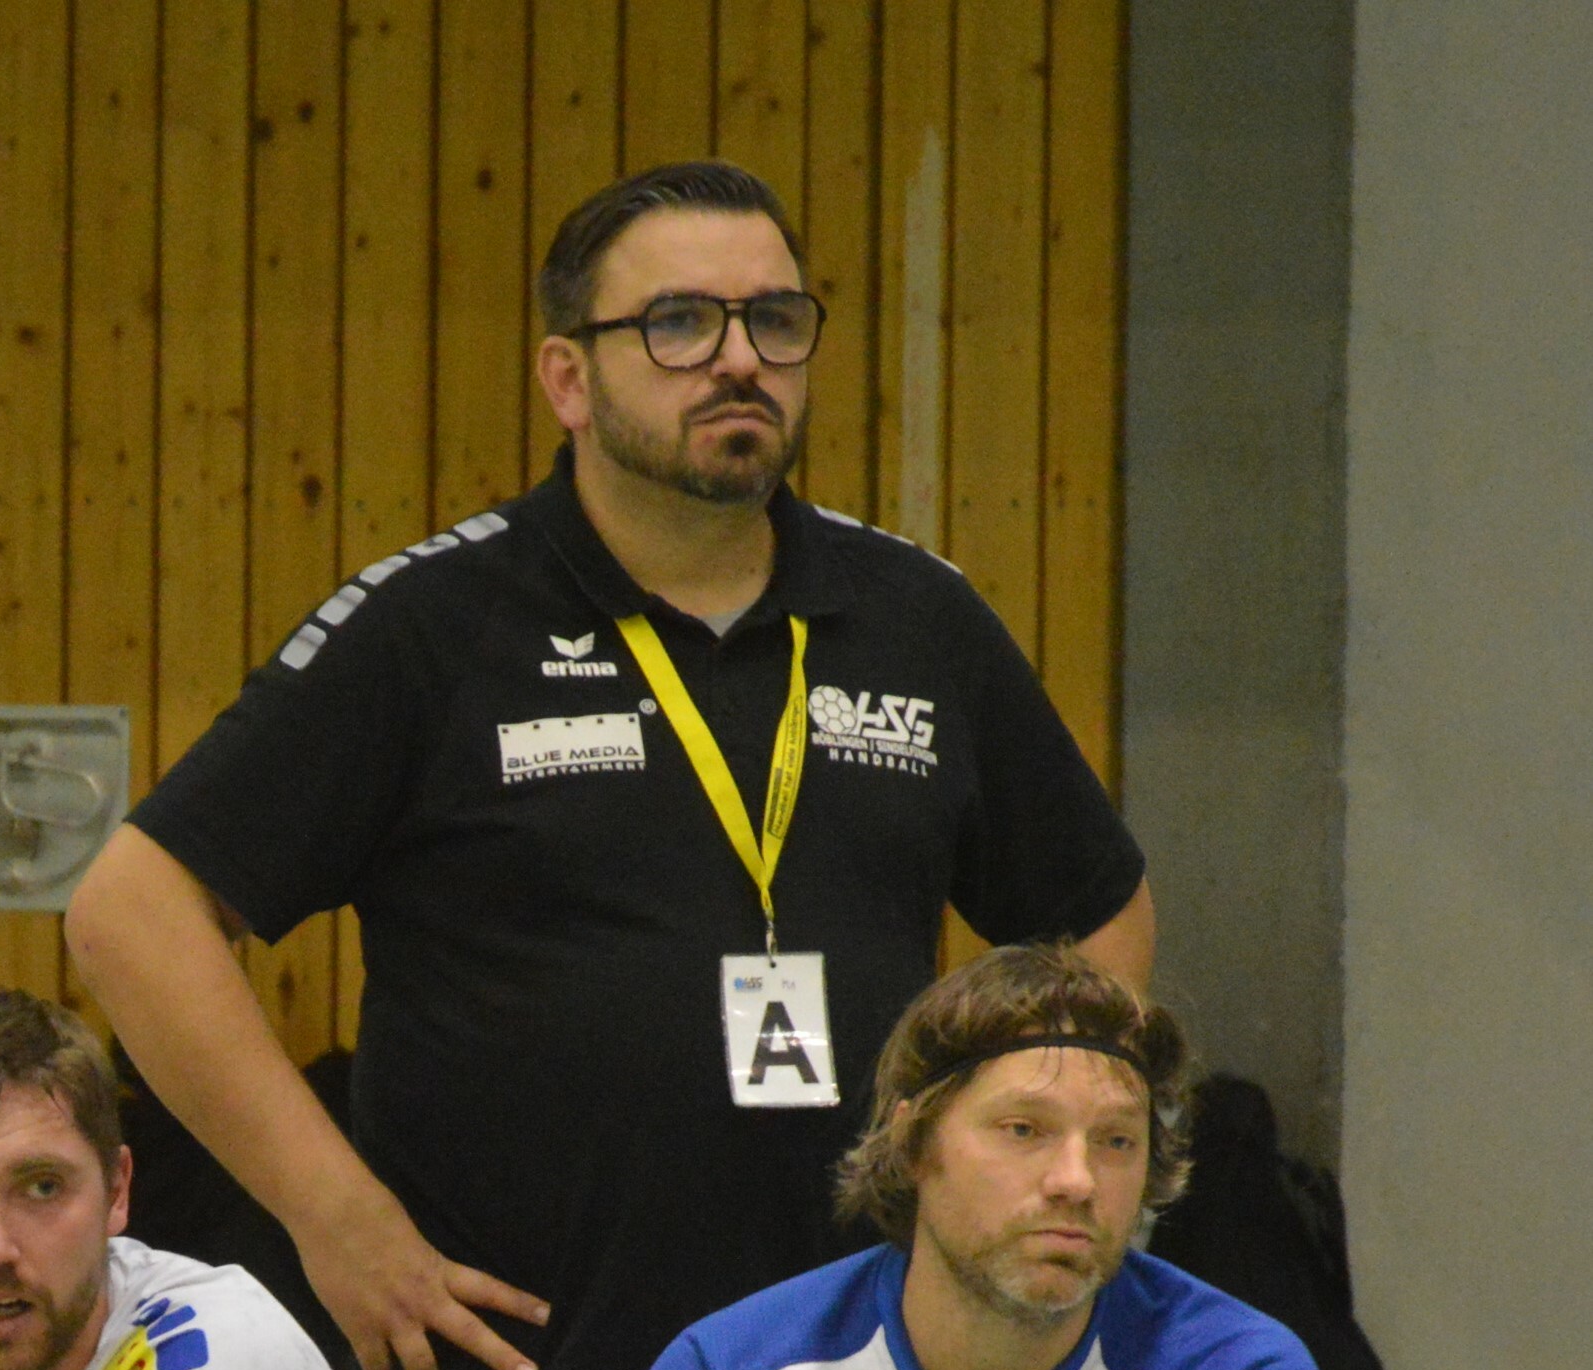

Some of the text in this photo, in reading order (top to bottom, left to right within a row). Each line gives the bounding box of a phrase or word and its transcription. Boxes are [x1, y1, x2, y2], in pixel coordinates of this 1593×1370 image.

[541, 660, 618, 677] erima
[854, 690, 935, 749] HSG
[569, 745, 640, 760] MEDIA
[828, 747, 929, 777] HANDBALL
[502, 759, 646, 785] ENTERTAINMENT
[747, 1001, 821, 1085] A
